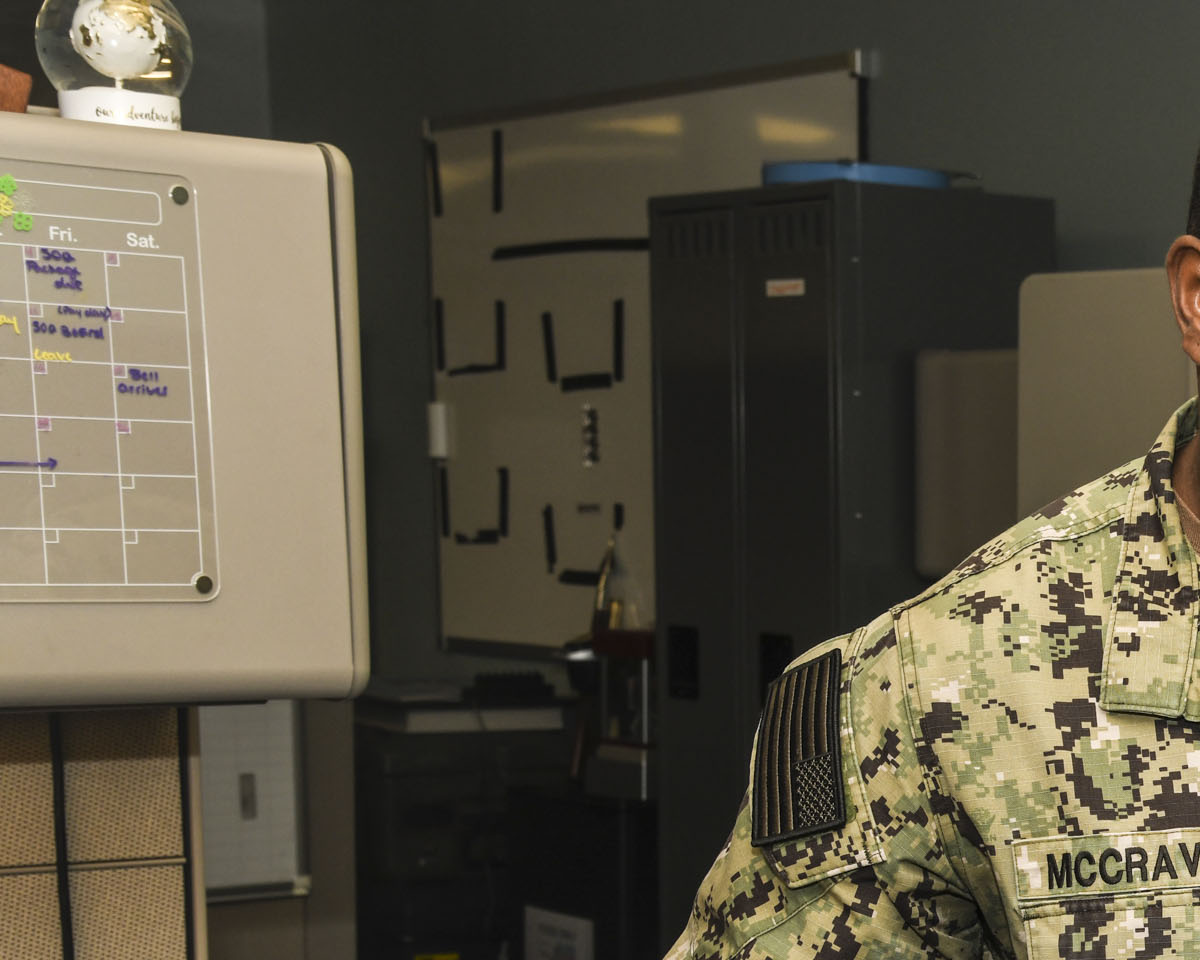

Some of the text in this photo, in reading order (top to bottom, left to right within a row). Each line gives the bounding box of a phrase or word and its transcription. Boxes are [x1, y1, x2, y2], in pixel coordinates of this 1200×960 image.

[125, 105, 168, 122] dventure
[49, 226, 78, 243] Fri.
[126, 233, 160, 249] Sat.
